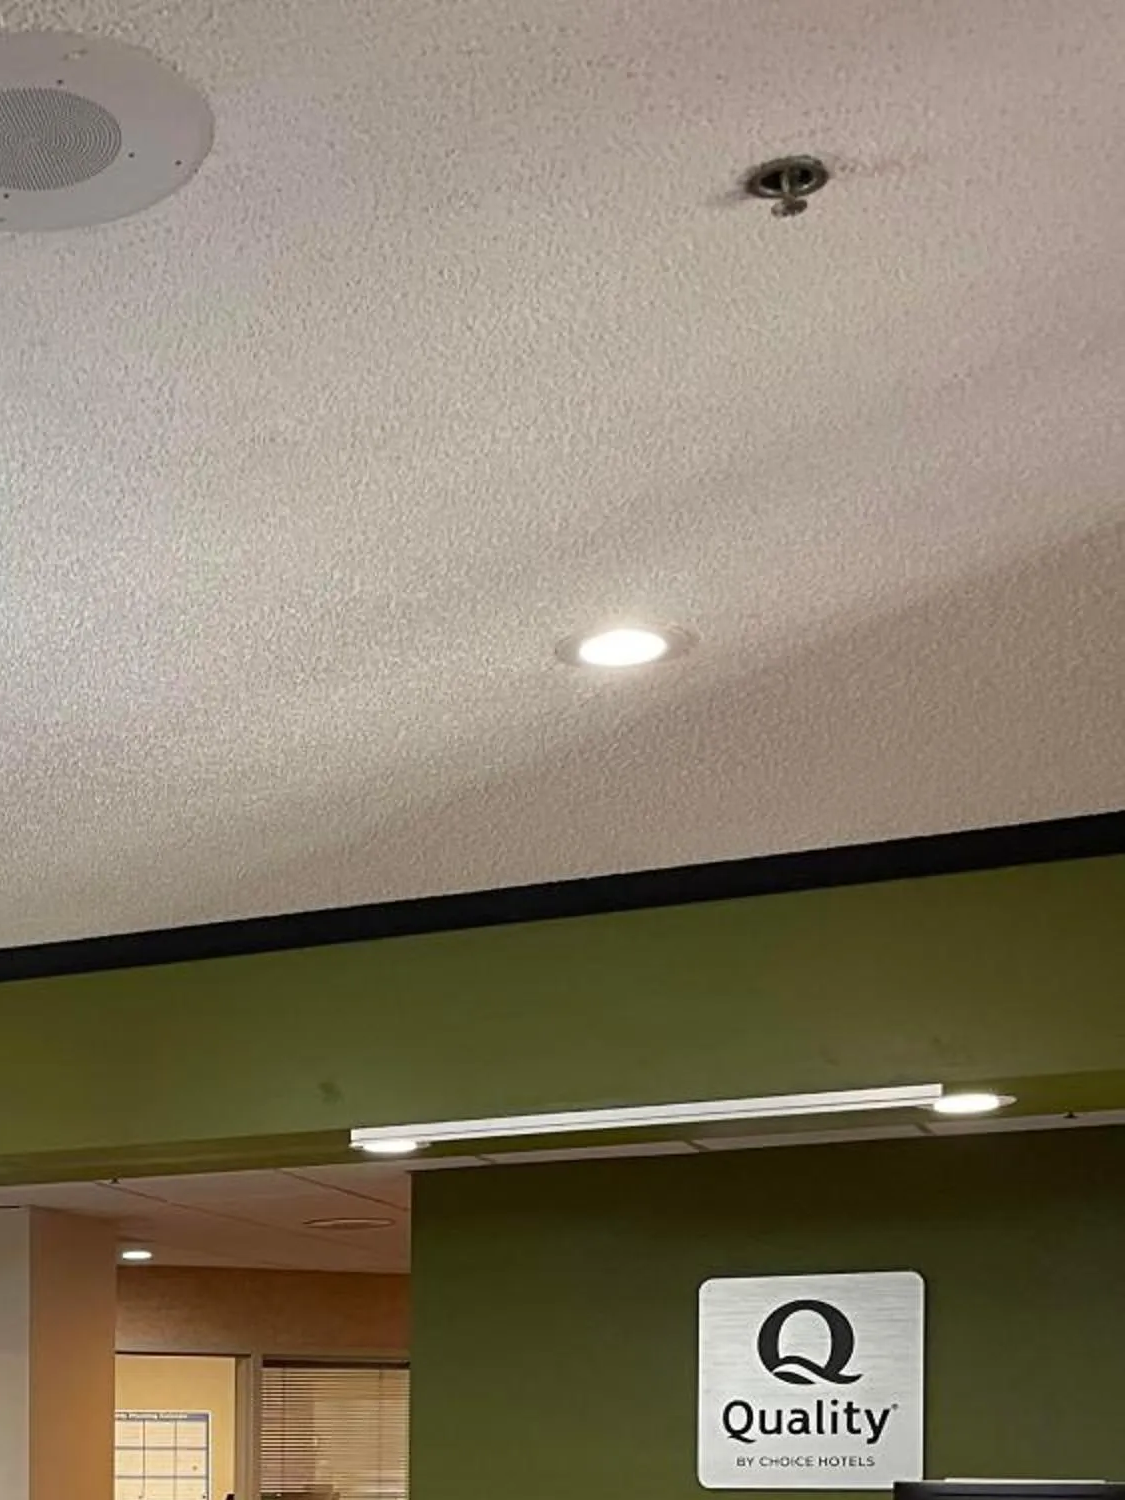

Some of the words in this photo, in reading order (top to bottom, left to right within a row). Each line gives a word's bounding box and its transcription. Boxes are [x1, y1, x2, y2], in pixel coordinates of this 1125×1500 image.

[757, 1299, 863, 1385] Q
[722, 1399, 891, 1445] Quality
[736, 1456, 755, 1467] BY
[759, 1456, 814, 1467] CHOICE
[818, 1456, 876, 1467] HOTELS
